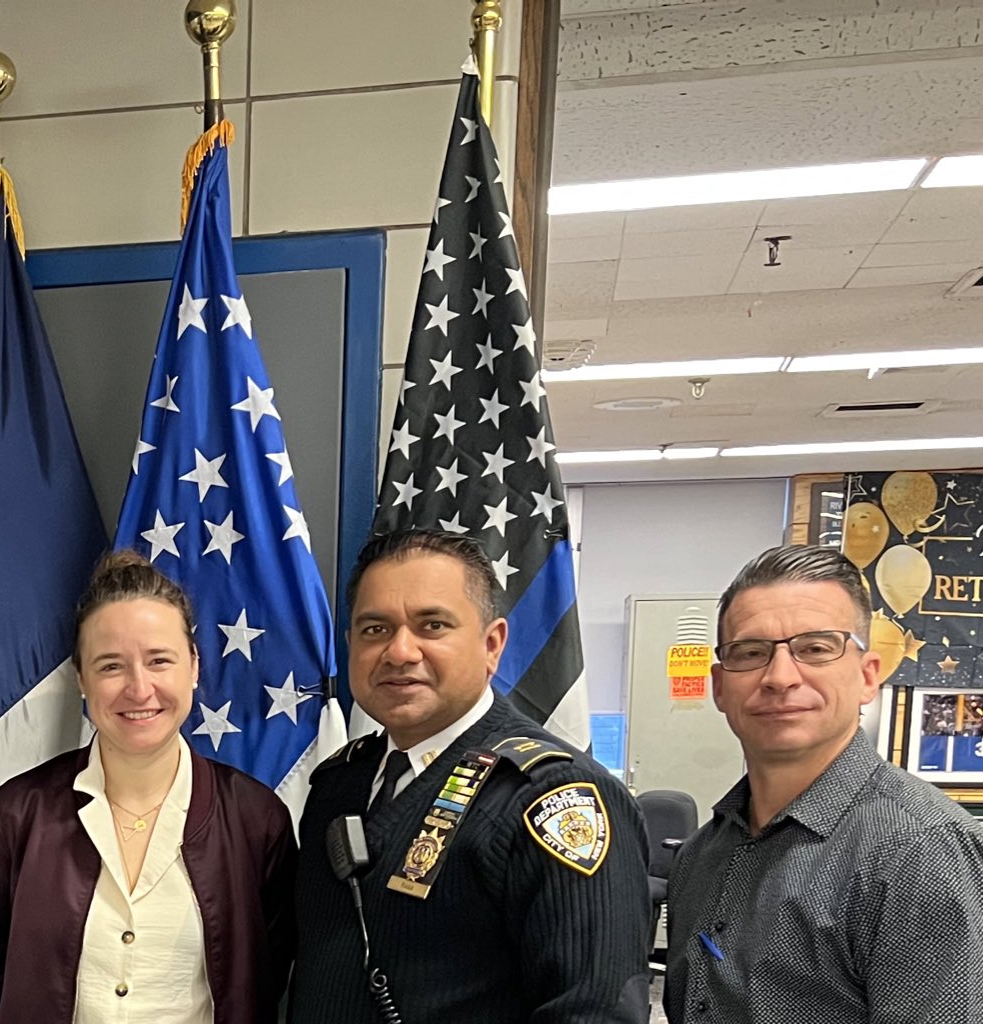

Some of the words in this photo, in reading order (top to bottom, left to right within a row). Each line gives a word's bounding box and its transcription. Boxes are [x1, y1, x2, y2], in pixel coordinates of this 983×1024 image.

[933, 574, 983, 602] RET
[533, 796, 596, 828] DEPARTMENT
[541, 788, 580, 810] POLICE
[595, 812, 606, 838] YORK
[542, 833, 566, 852] CITY
[564, 850, 580, 861] OF
[591, 839, 604, 861] NEW
